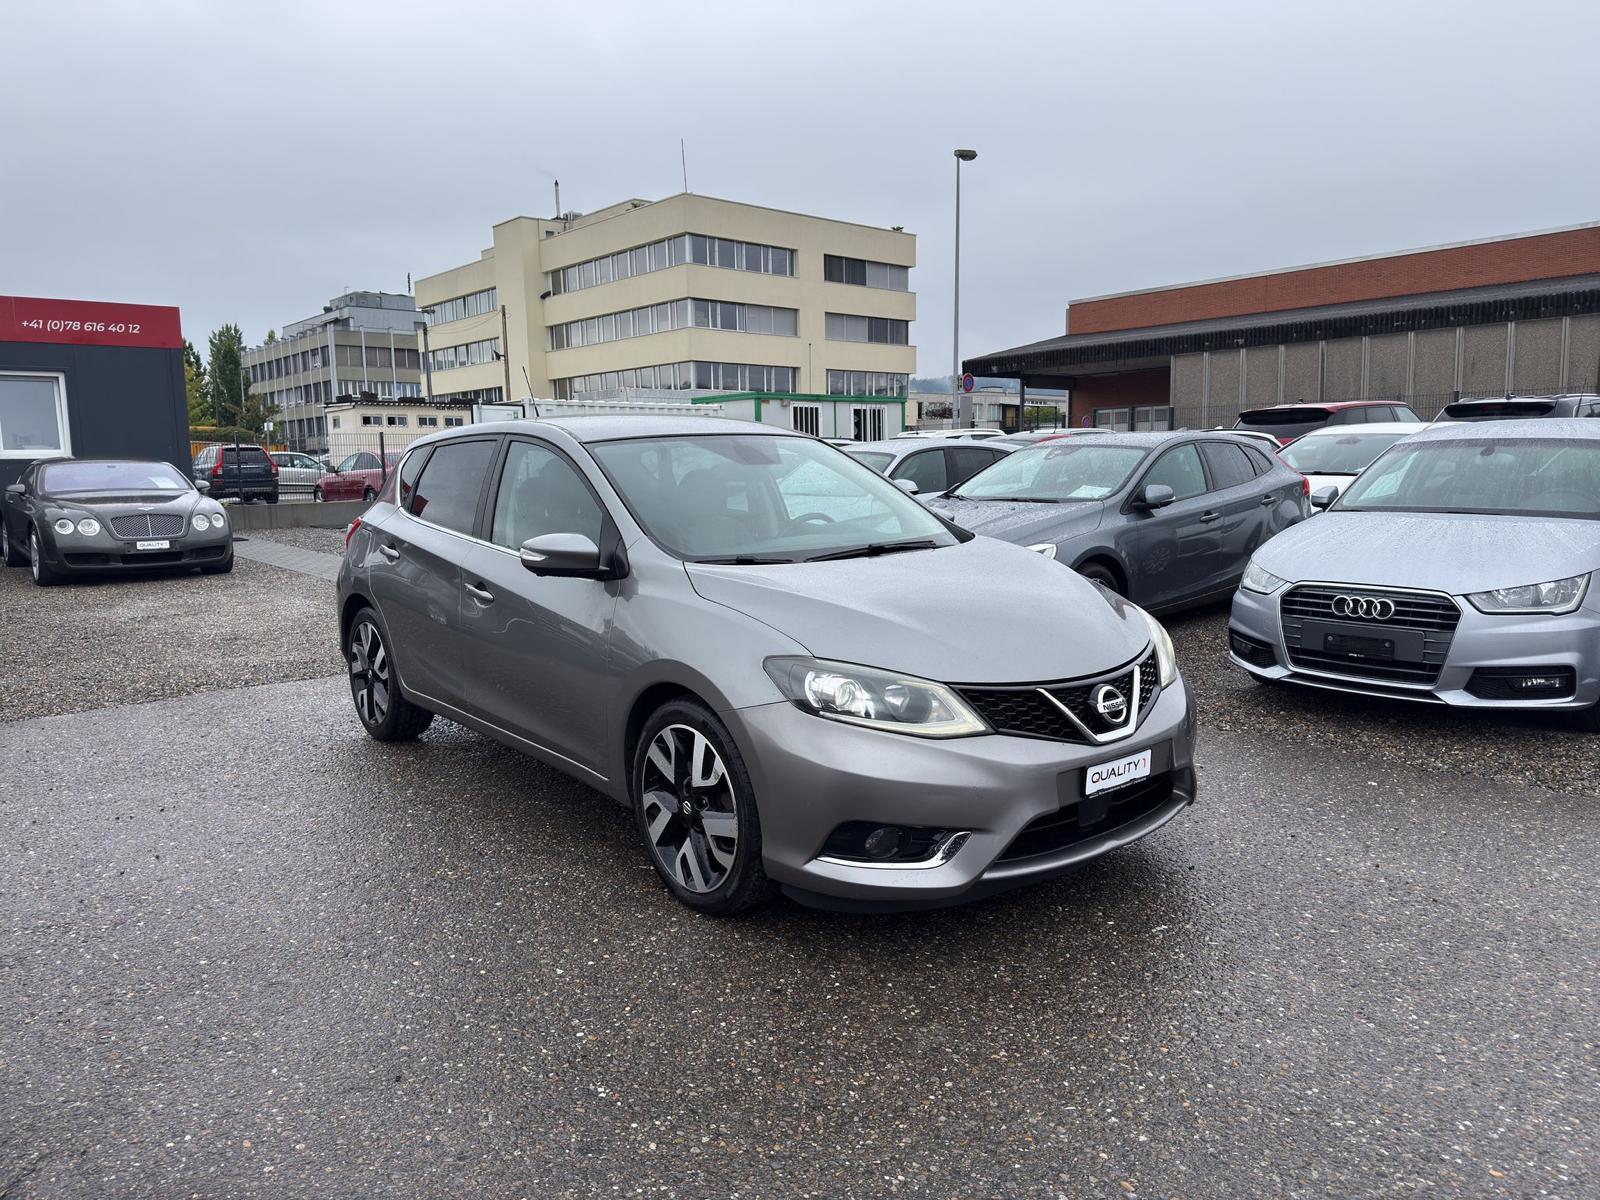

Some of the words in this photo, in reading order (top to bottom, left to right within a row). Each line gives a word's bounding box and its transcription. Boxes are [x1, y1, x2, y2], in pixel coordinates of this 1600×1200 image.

[21, 319, 43, 329] +41
[47, 319, 81, 332] (0)78
[83, 322, 105, 332] 616
[107, 323, 125, 333] 40
[128, 324, 141, 334] 12
[1091, 759, 1141, 784] QUALITY
[1142, 757, 1147, 769] 1
